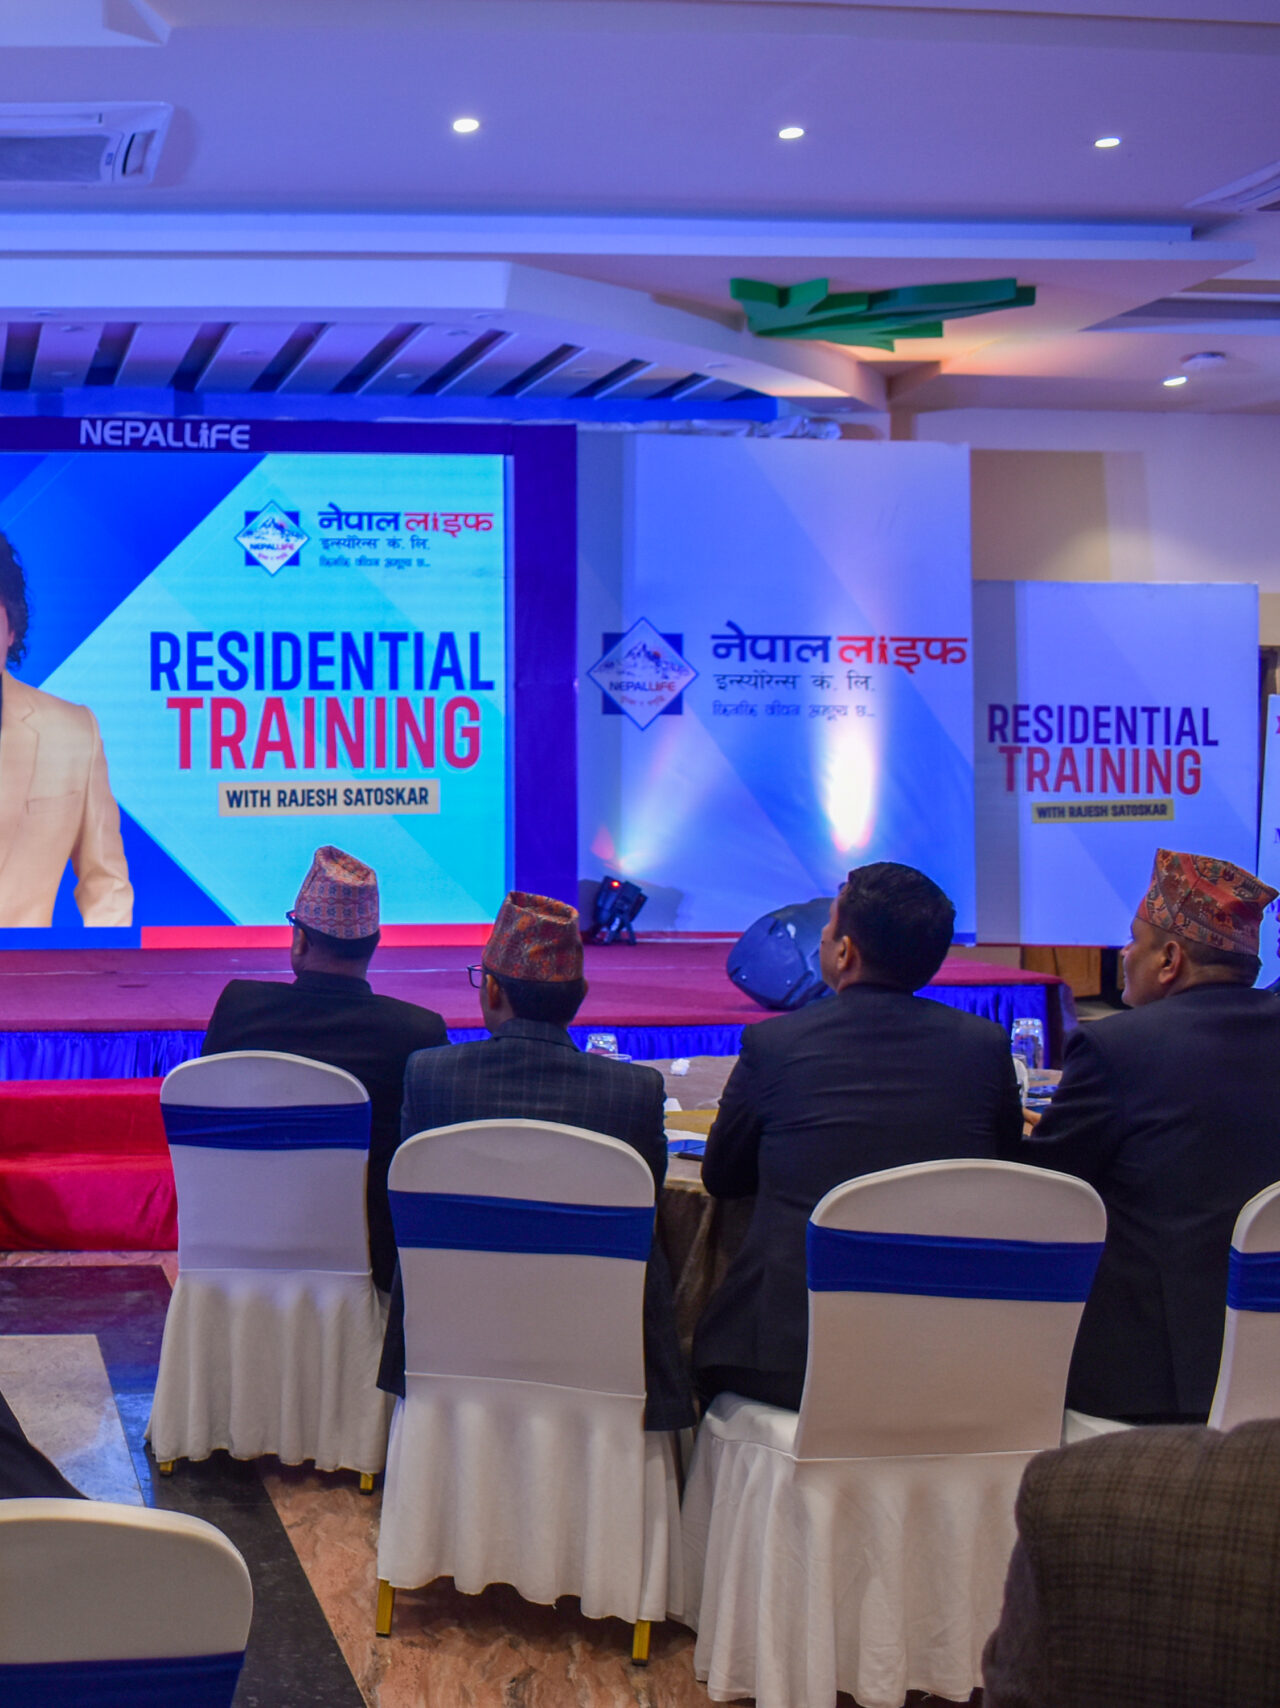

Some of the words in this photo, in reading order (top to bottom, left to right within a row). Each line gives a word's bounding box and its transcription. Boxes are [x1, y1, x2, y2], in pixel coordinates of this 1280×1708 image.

[318, 502, 401, 531] नेपाल
[404, 511, 494, 538] लाइफ
[149, 630, 495, 692] RESIDENTIAL
[710, 620, 832, 663] नेपाल
[837, 636, 968, 674] लाइफ
[166, 695, 482, 770] TRAINING
[987, 703, 1219, 747] RESIDENTIAL
[998, 746, 1201, 796] TRAINING
[226, 789, 271, 809] WITH
[277, 788, 337, 808] RAJESH
[342, 786, 430, 806] SATOSKAR
[1036, 806, 1066, 819] WITH
[1068, 804, 1108, 818] RAJESH
